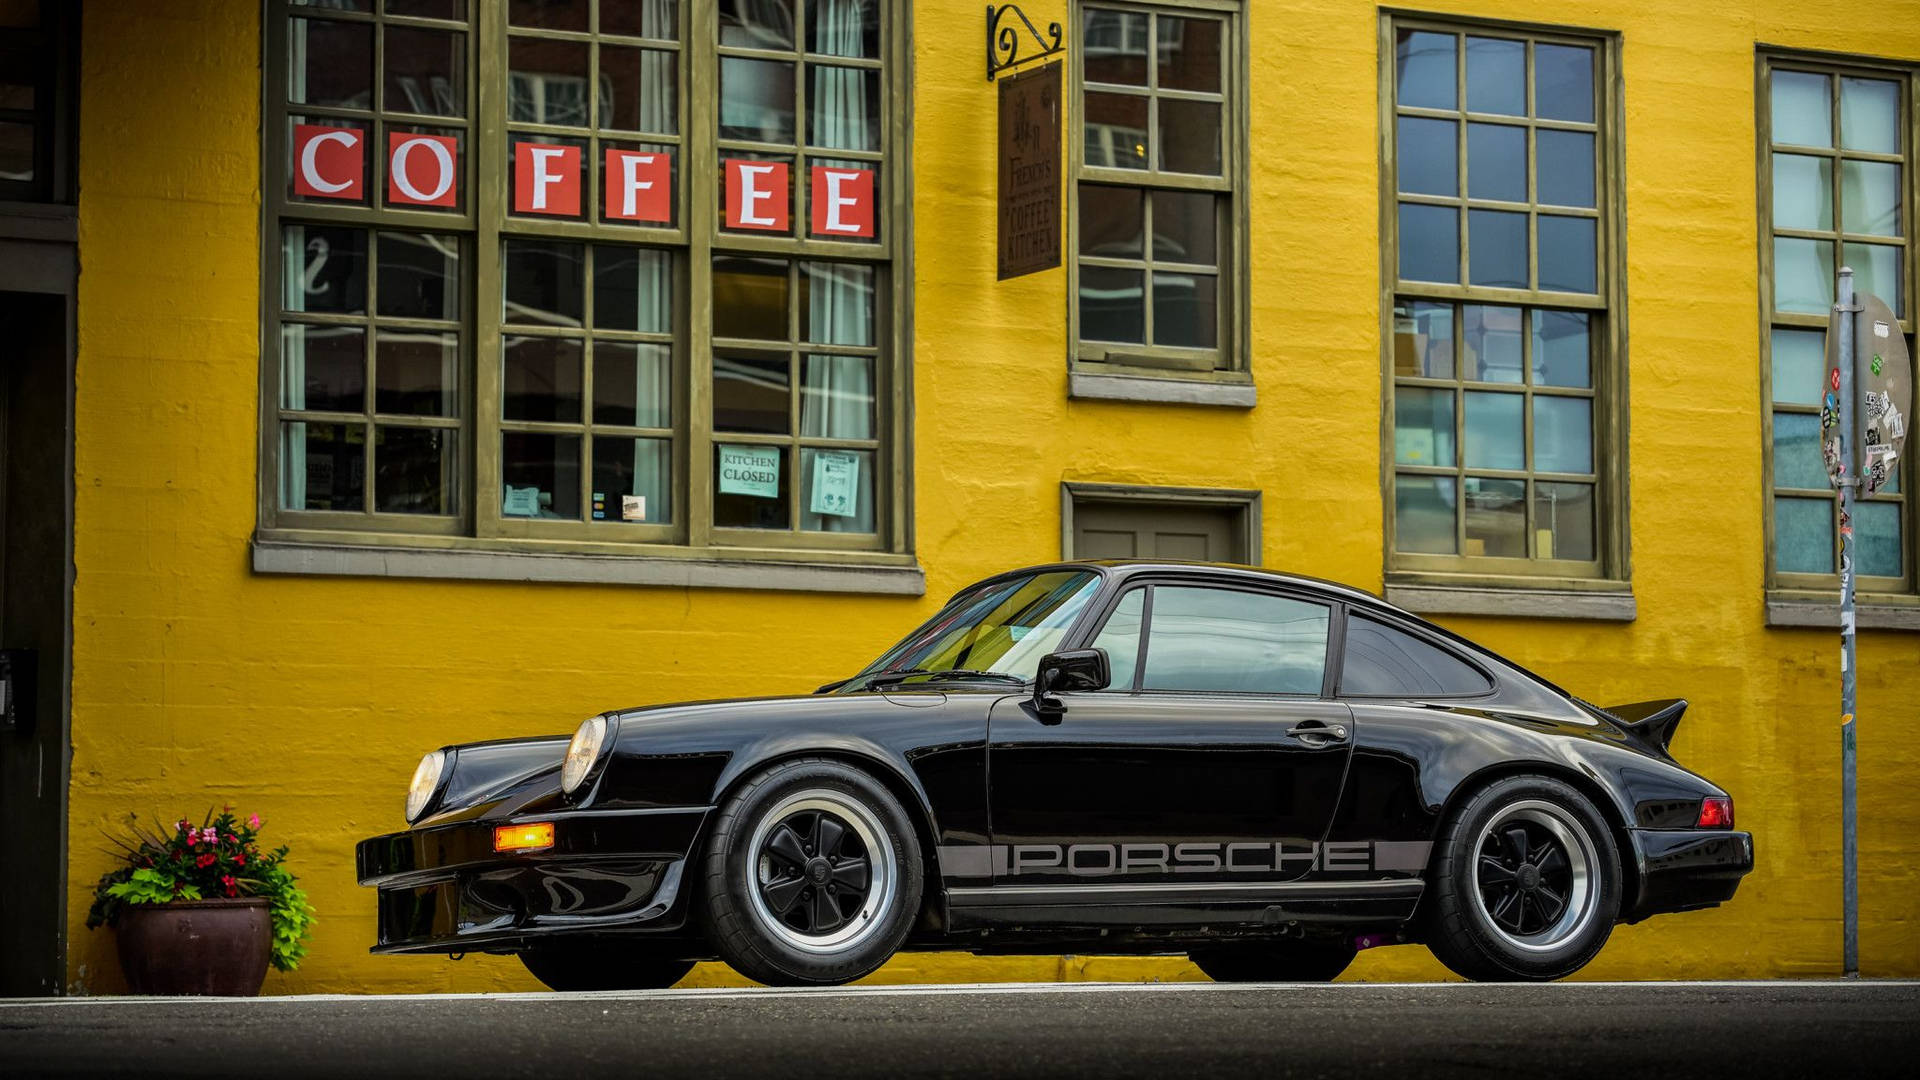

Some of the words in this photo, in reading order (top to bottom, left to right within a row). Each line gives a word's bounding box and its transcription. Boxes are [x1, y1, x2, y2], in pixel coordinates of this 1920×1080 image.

[301, 131, 860, 233] COFFEE
[1010, 199, 1049, 233] COFFEE
[1008, 228, 1052, 262] KITCHEN
[724, 453, 776, 467] KITCHEN
[724, 468, 776, 483] CLOSED
[1013, 842, 1370, 874] PORSCHE
